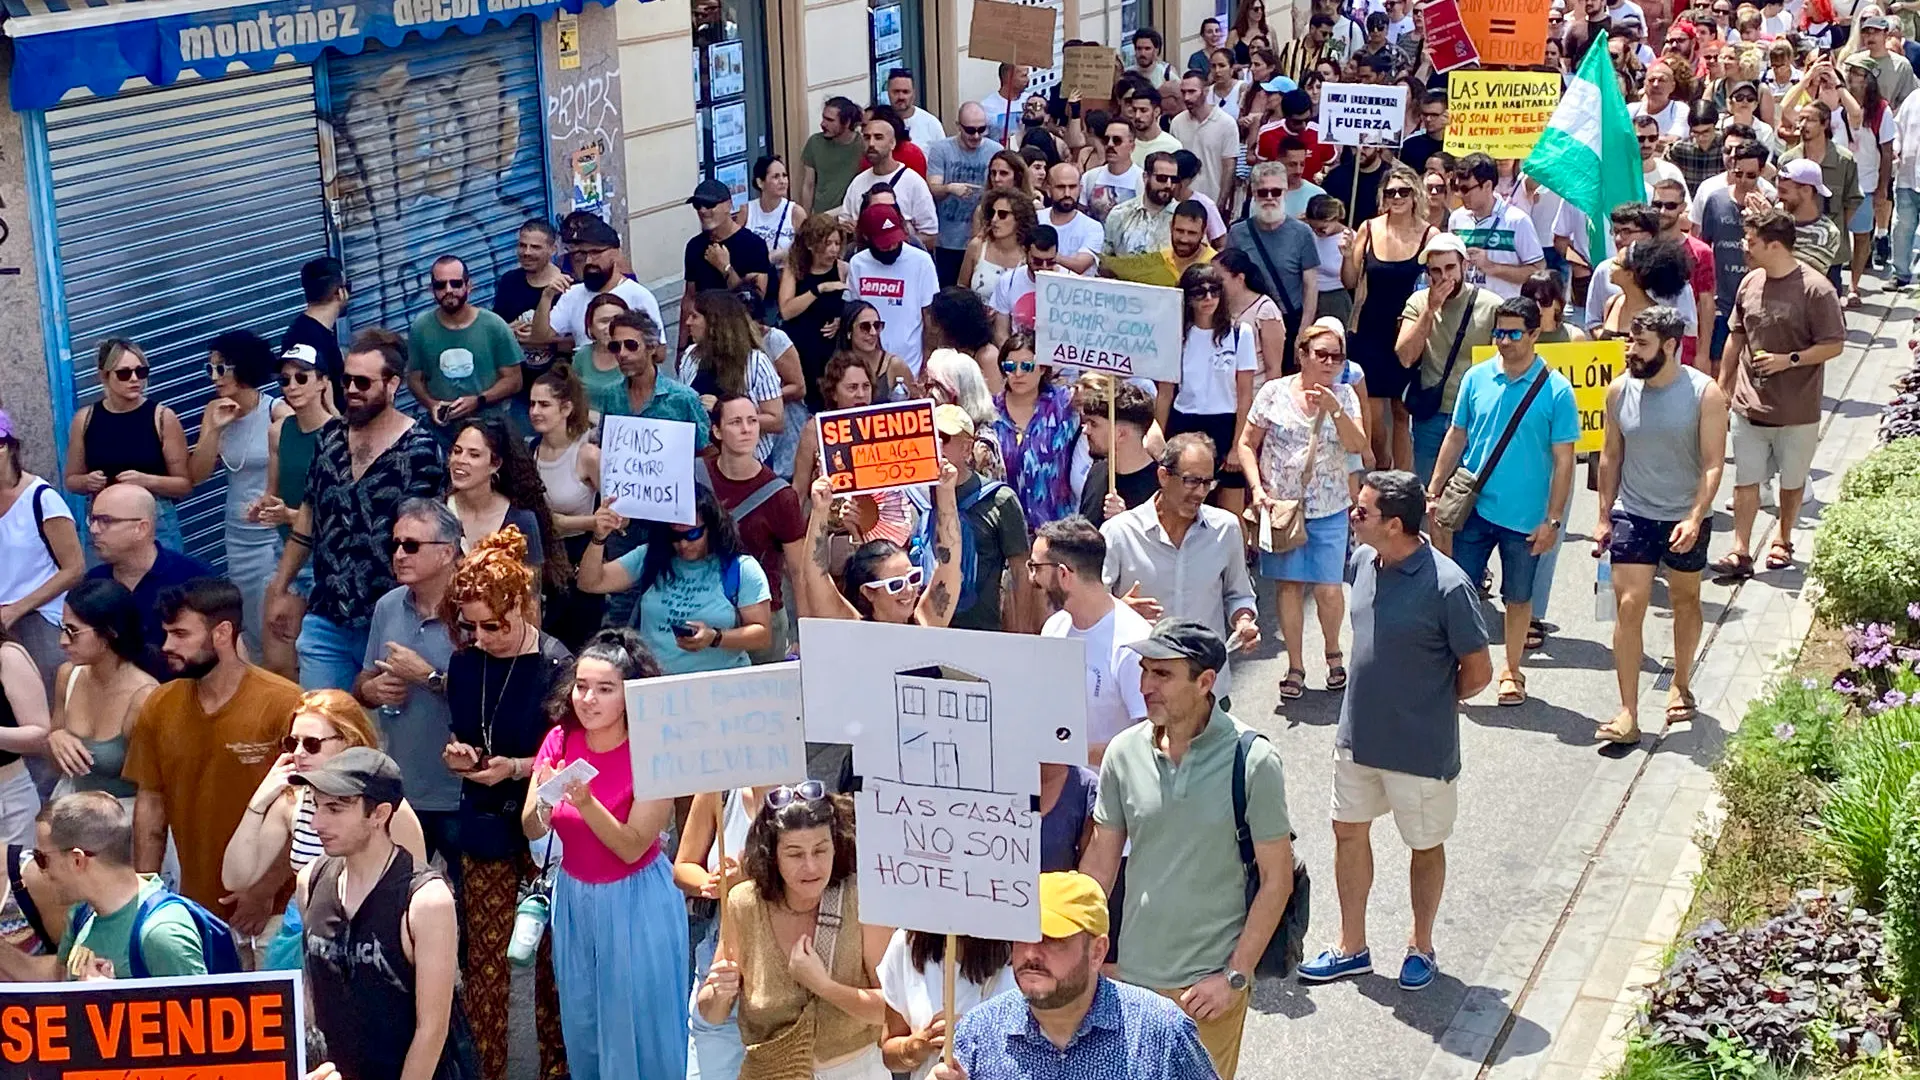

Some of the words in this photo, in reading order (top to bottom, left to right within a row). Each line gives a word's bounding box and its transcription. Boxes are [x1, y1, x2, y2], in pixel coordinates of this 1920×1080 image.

[180, 5, 359, 62] montañez
[1328, 93, 1347, 103] LA
[1451, 78, 1478, 99] LAS
[1486, 81, 1557, 97] VIVIENDAS
[1450, 112, 1466, 124] NO
[1469, 112, 1489, 123] SON
[1451, 101, 1470, 111] SON
[1474, 101, 1498, 109] PARA
[1336, 117, 1391, 130] FUERZA
[1449, 125, 1463, 136] NI
[1468, 126, 1505, 136] ACTIVOS
[861, 279, 902, 295] Senpai
[1046, 282, 1145, 315] QUEREMOS
[1049, 307, 1106, 333] DORMIR
[1117, 320, 1155, 337] CON
[1049, 328, 1071, 343] LA
[1074, 332, 1158, 358] VENTANA
[1053, 343, 1133, 372] ABIERTA
[1558, 356, 1612, 388] LÓN
[608, 424, 663, 454] VECINOS
[823, 419, 853, 445] SE
[856, 409, 933, 440] VENDE
[624, 457, 664, 477] CENTRO
[875, 790, 937, 816] LAS
[948, 801, 1033, 829] CASAS
[903, 819, 954, 856] NO
[963, 831, 1031, 865] SON
[874, 853, 1031, 908] HOTELES
[1, 1006, 70, 1063] SE
[85, 994, 285, 1059] VENDE
